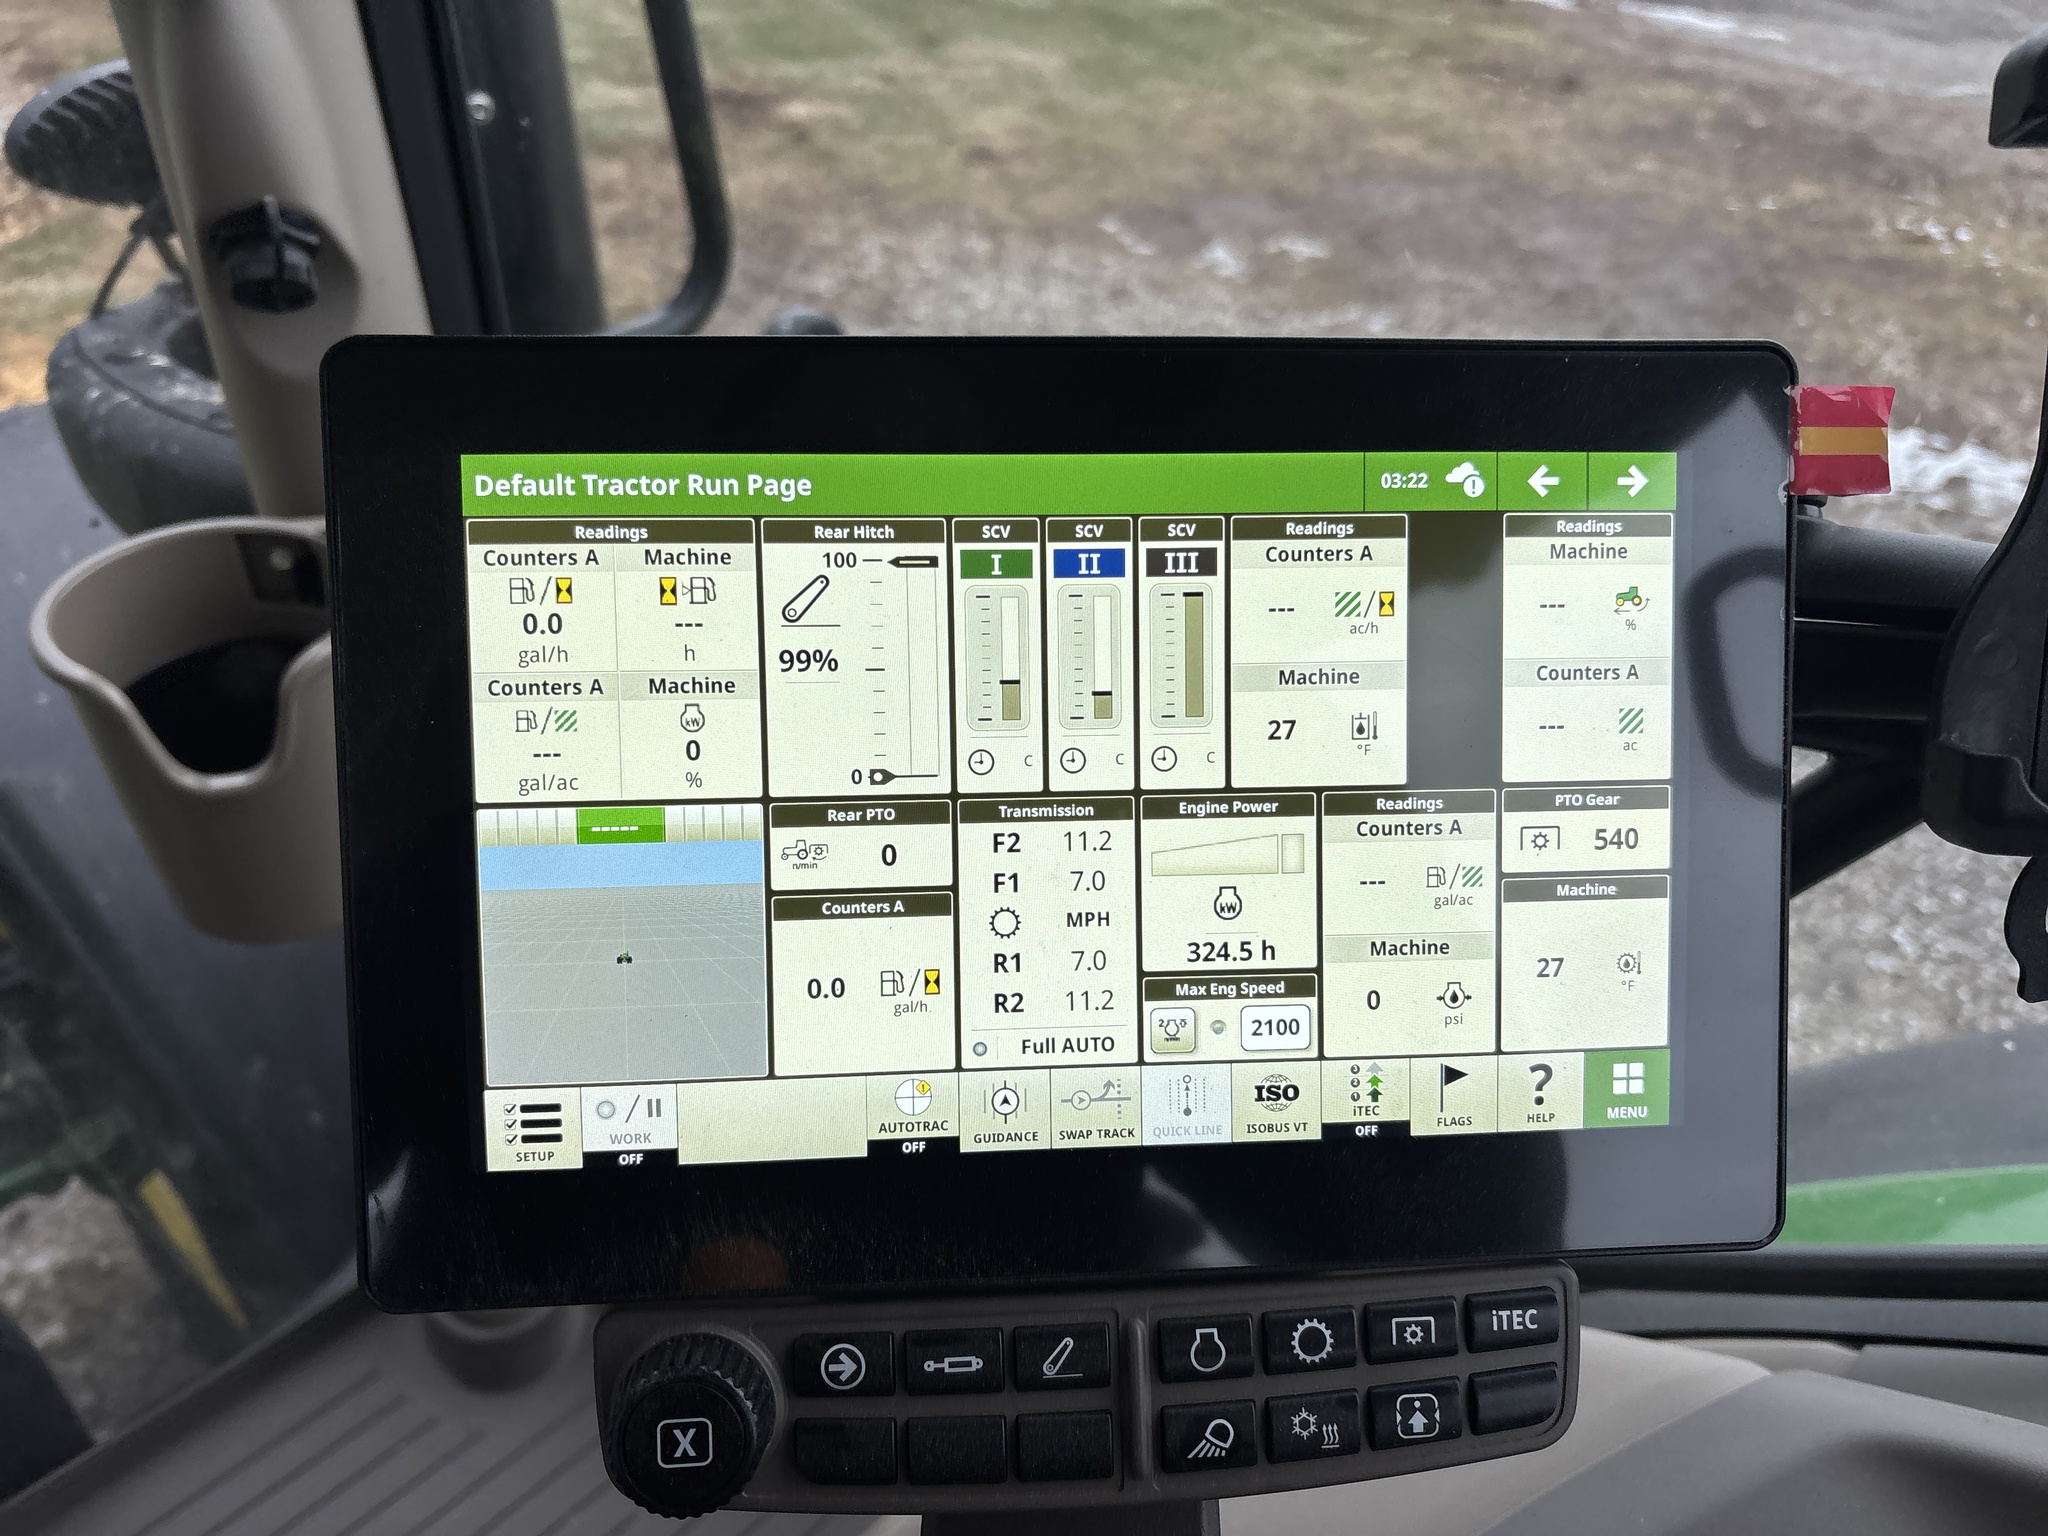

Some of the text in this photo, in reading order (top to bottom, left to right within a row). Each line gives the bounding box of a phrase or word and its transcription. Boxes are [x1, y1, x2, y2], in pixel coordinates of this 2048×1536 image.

[474, 473, 811, 502] Default Tractor Run Page
[1381, 473, 1428, 488] 03:22
[574, 525, 648, 541] Readings
[814, 524, 894, 539] Rear Hitch
[982, 525, 1010, 539] SCV
[1075, 524, 1103, 538] SCV
[1168, 523, 1196, 537] SCV
[1285, 521, 1354, 537] Readings
[1556, 520, 1622, 535] Readings
[483, 550, 599, 567] Counters A
[644, 549, 732, 566] Machine
[1265, 545, 1373, 562] Counters A
[1550, 543, 1628, 559] Machine
[822, 553, 857, 569] 100
[991, 555, 1001, 575] I
[1078, 554, 1100, 574] II
[1164, 552, 1199, 573] III
[522, 613, 563, 635] 0.0
[1349, 621, 1379, 634] ac/h
[1625, 619, 1637, 631] %
[518, 646, 569, 667] gal/h
[684, 645, 695, 661] h
[779, 649, 839, 673] 99%
[1279, 669, 1360, 686] Machine
[1536, 665, 1639, 681] Counters A
[487, 679, 604, 697] Counters A
[648, 678, 736, 695] Machine
[1267, 720, 1296, 740] 27
[686, 740, 701, 761] 0
[1623, 741, 1637, 751] ac
[1024, 755, 1033, 767] C
[1115, 753, 1124, 765] C
[1207, 752, 1215, 764] C
[518, 774, 579, 796] gal/ac
[685, 772, 703, 788] %
[851, 770, 862, 785] 0
[1376, 798, 1443, 812] Readings
[1555, 794, 1621, 806] PTO Gear
[827, 808, 895, 821] Rear PTO
[999, 804, 1094, 818] Transmission
[1179, 801, 1278, 817] Engine Power
[1357, 820, 1462, 837] Counters A
[992, 831, 1112, 853] F2 11.2
[1594, 828, 1639, 850] 540
[881, 844, 897, 866] 0
[792, 861, 818, 869] n/min
[993, 871, 1105, 893] F1 7.0
[1556, 883, 1617, 896] Machine
[822, 900, 905, 915] Counters A
[1434, 894, 1473, 909] gal/ac
[1066, 912, 1110, 928] MPH
[1187, 940, 1276, 962] 324.5 h
[1370, 940, 1450, 956] Machine
[993, 951, 1106, 973] R1 7.0
[1536, 958, 1564, 977] 27
[807, 977, 845, 999] 0.0
[1175, 981, 1285, 997] Max Eng Speed
[994, 990, 1114, 1013] R2 11.2
[1367, 990, 1381, 1010] 0
[894, 1001, 928, 1017] gal/h
[1251, 1019, 1300, 1036] 2100
[1444, 1014, 1463, 1028] psi
[1021, 1037, 1115, 1054] Full AUTO
[1255, 1084, 1299, 1102] ISO
[1352, 1105, 1380, 1117] iTEC
[1527, 1113, 1555, 1123] HELP
[1607, 1106, 1648, 1119] MENU
[878, 1121, 949, 1134] AUTOTRAC
[1247, 1122, 1308, 1134] ISOBUS VT
[1437, 1115, 1472, 1127] FLAGS
[610, 1132, 652, 1145] WORK
[973, 1132, 1039, 1143] GUIDANCE
[1059, 1128, 1135, 1141] SWAP TRACK
[1152, 1125, 1223, 1138] QUICK LINE
[1355, 1125, 1378, 1136] OFF
[902, 1141, 926, 1153] OFF
[515, 1151, 555, 1162] SETUP
[619, 1153, 643, 1166] OFF
[1491, 1308, 1538, 1331] iTEC
